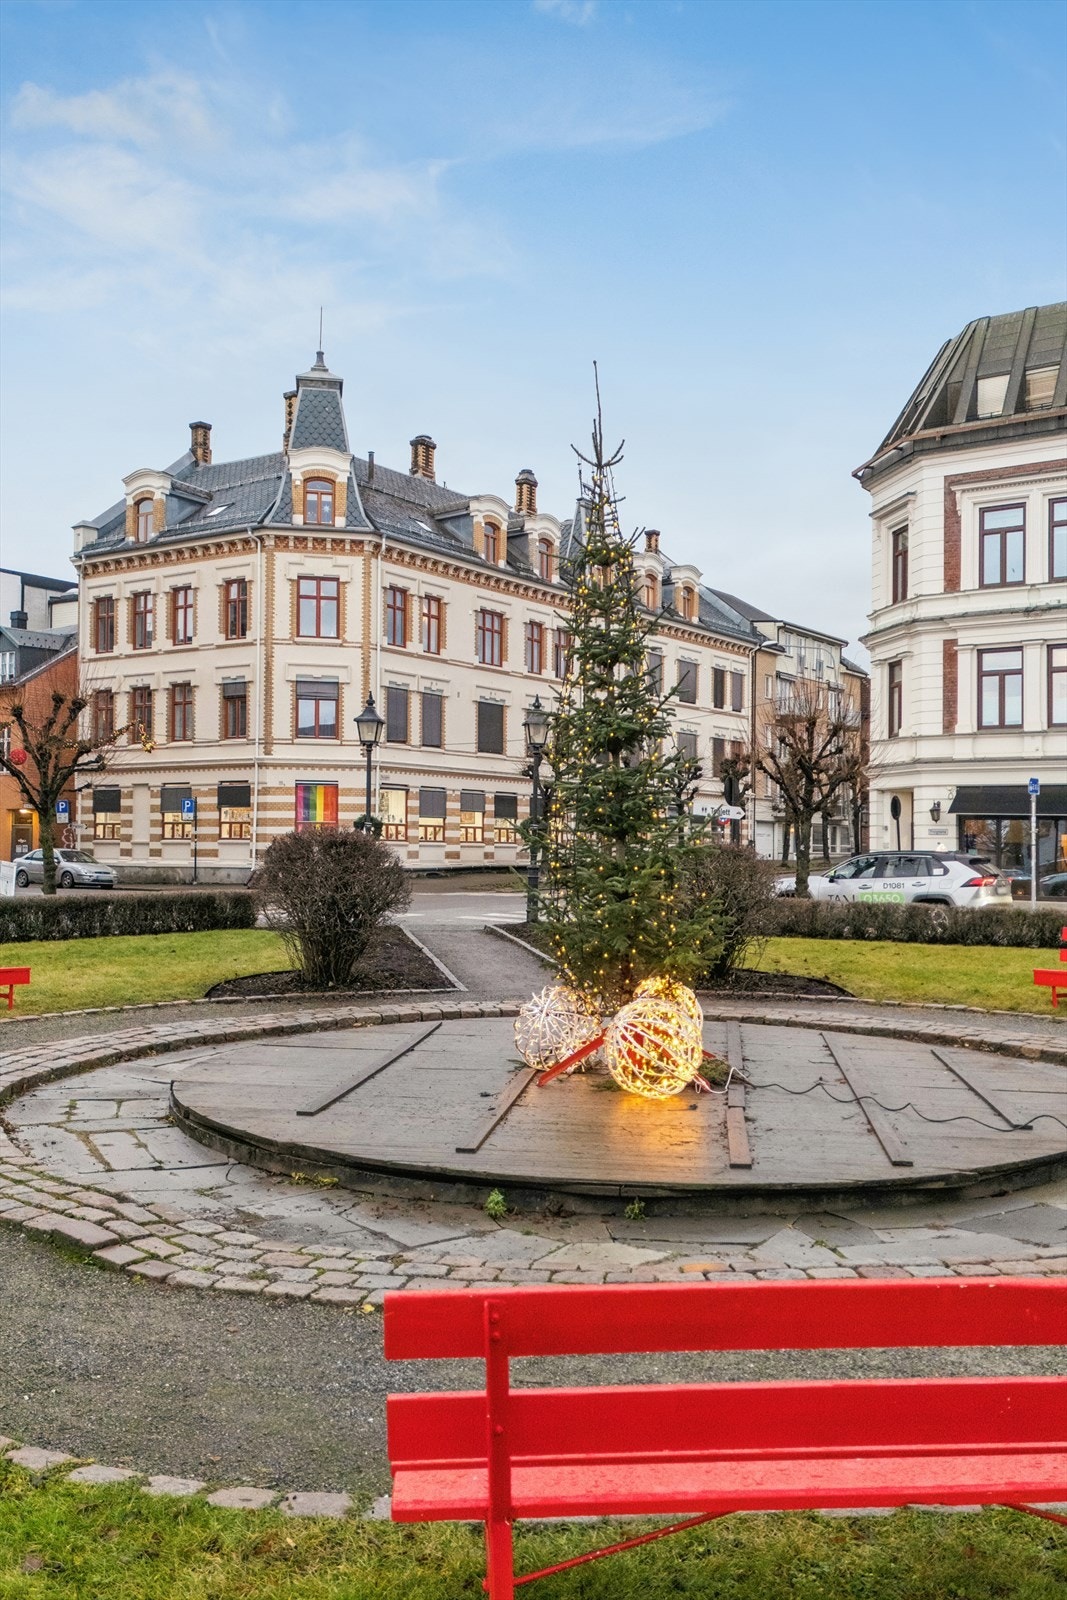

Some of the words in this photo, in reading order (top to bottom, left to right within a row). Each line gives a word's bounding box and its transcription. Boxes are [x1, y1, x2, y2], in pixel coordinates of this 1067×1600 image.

[59, 801, 65, 812] P
[184, 800, 191, 812] P
[883, 882, 905, 890] D1081
[863, 894, 901, 903] 03650
